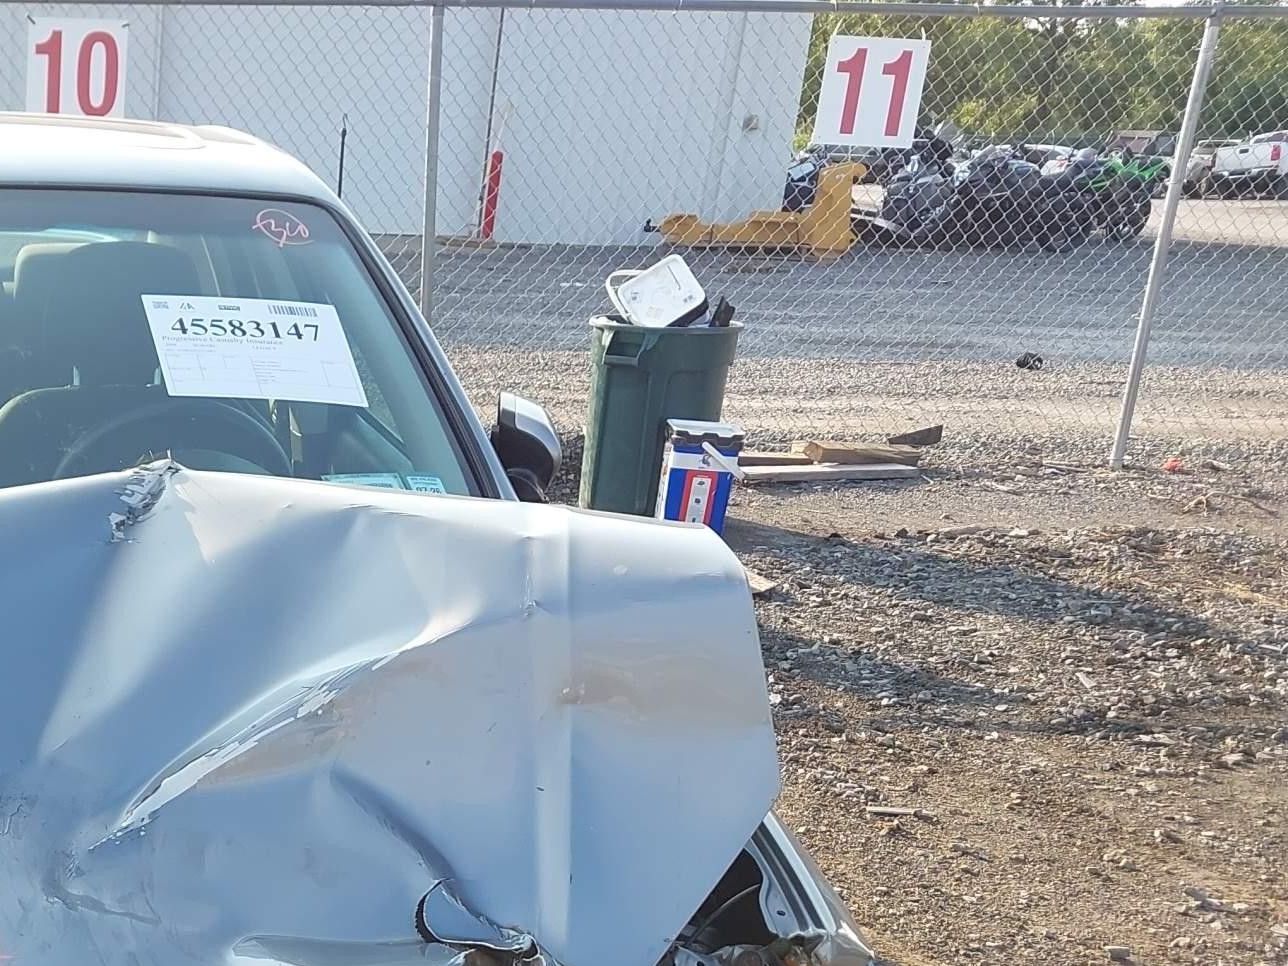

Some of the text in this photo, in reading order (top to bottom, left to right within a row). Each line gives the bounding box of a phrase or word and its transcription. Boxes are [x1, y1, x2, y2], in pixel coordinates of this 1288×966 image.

[34, 29, 119, 117] 10
[836, 47, 914, 137] 11
[170, 317, 320, 342] 45583147
